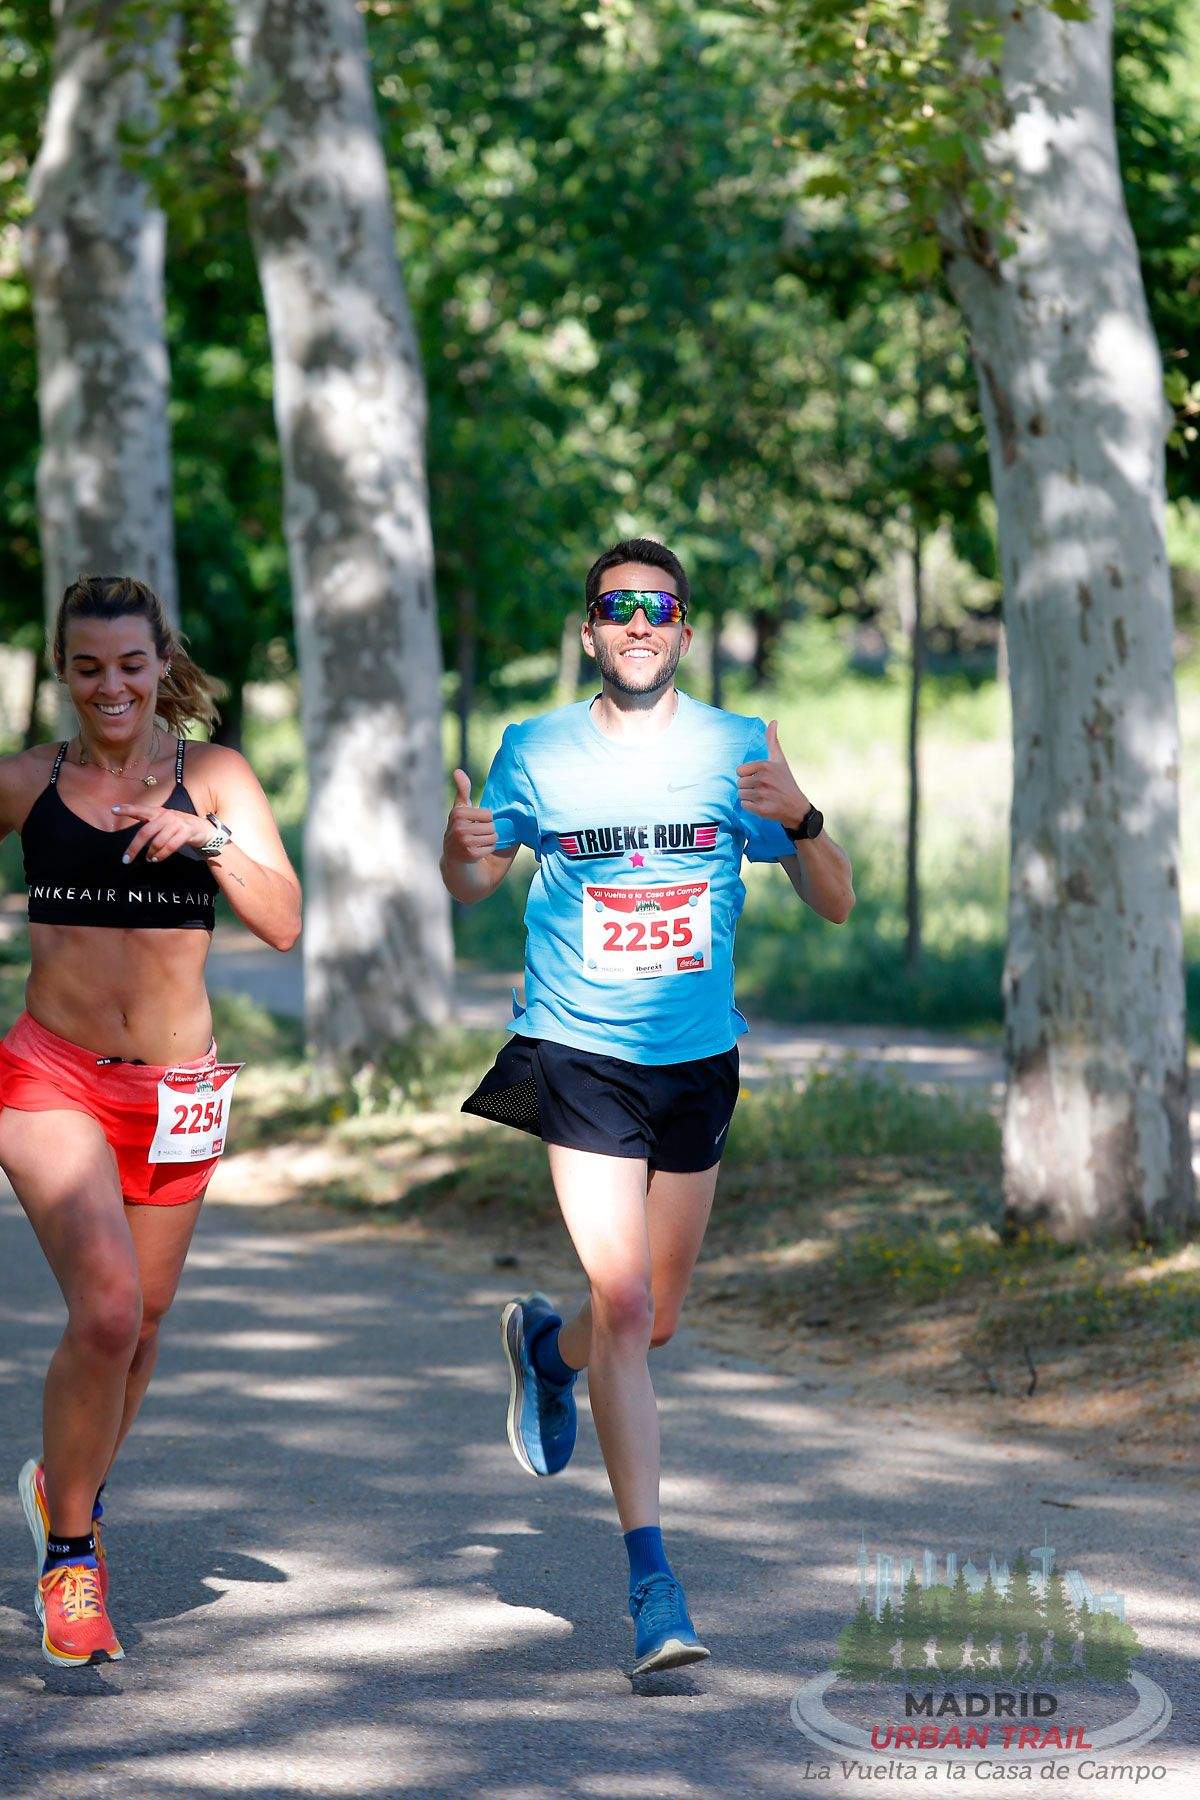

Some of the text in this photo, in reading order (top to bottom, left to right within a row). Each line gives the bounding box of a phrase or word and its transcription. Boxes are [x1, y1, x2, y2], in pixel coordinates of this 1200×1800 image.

[575, 823, 696, 853] TRUEKE RUN
[604, 891, 627, 900] Vuelta
[646, 891, 664, 899] Casa
[665, 889, 675, 897] de
[676, 886, 702, 897] Campo
[603, 917, 692, 951] 2255
[170, 1098, 223, 1135] 2254
